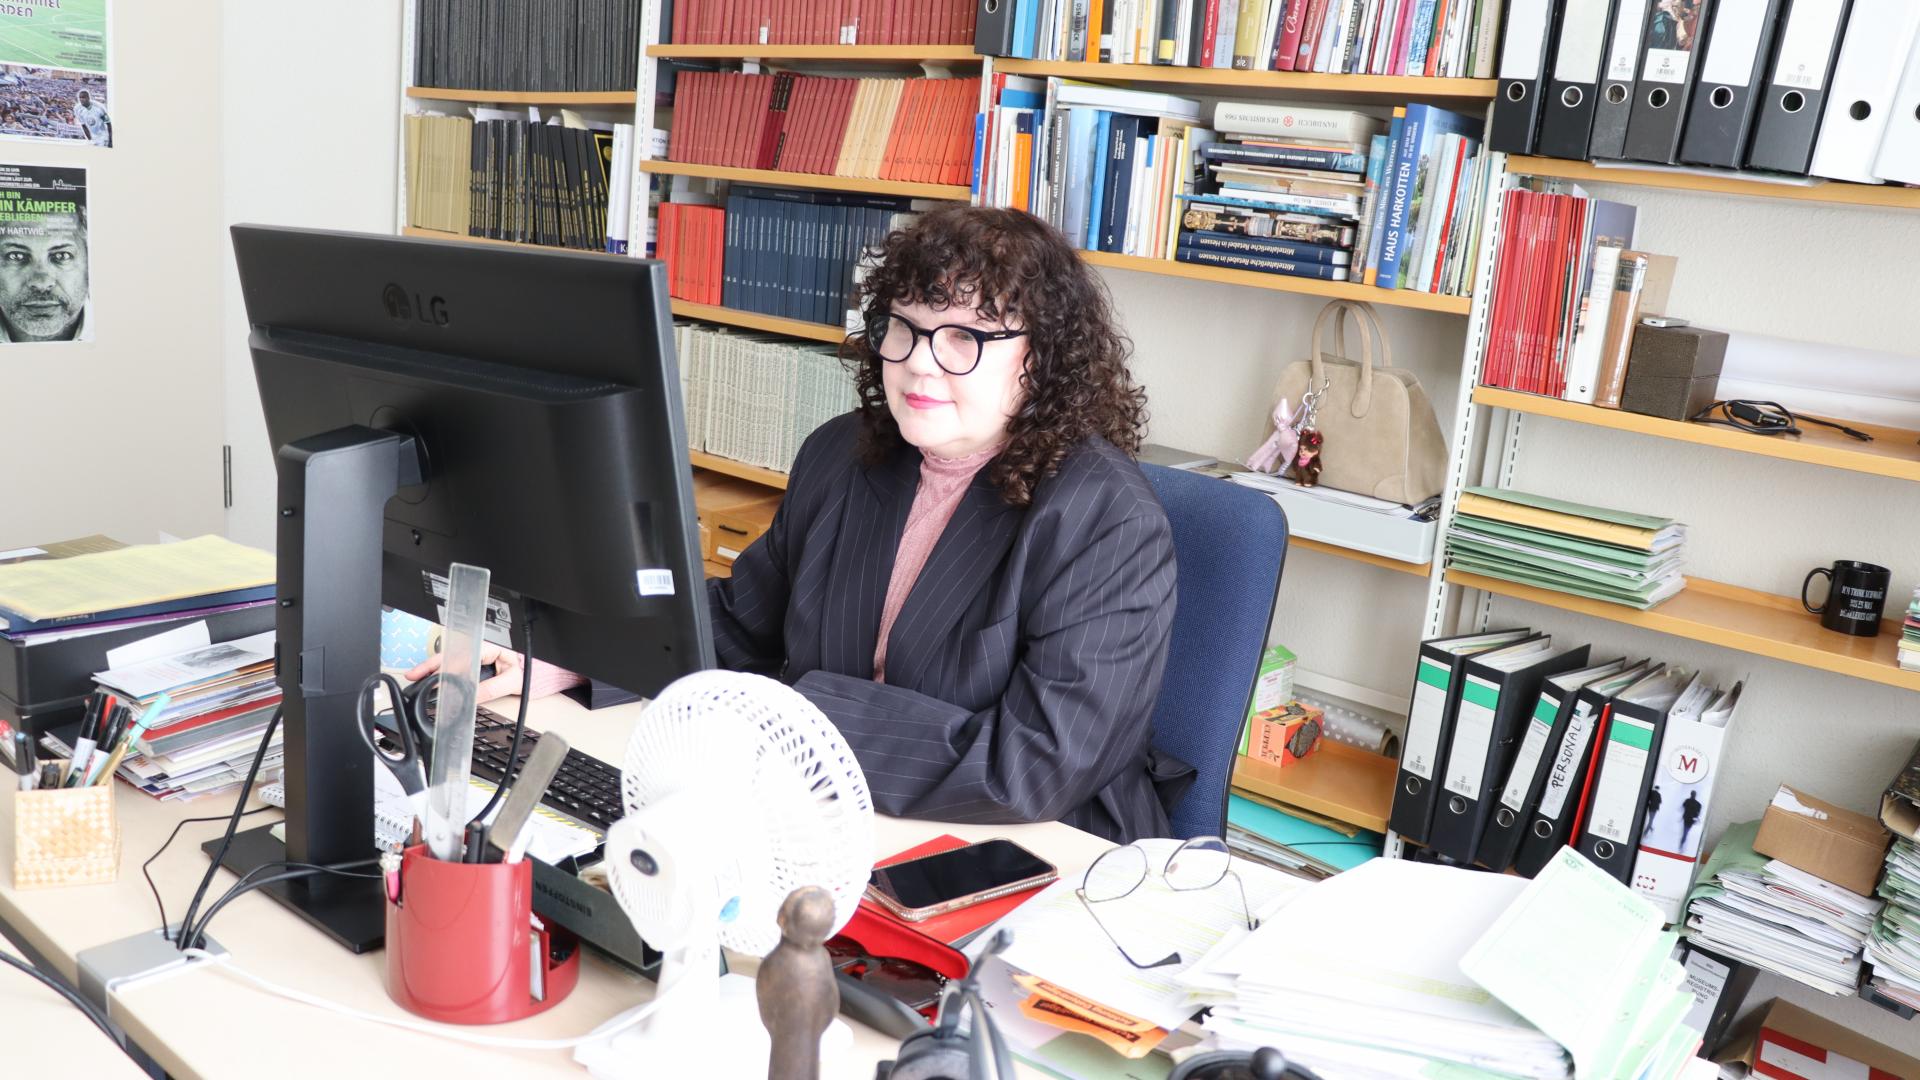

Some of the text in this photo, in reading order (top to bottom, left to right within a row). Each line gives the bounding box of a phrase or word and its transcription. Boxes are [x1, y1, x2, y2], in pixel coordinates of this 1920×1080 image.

[6, 191, 21, 199] BIN
[1390, 162, 1411, 228] HARKOTTEN
[16, 198, 77, 213] KÄMPFER
[7, 227, 45, 236] HARTWIG
[620, 243, 628, 252] K
[1200, 238, 1221, 247] Hessen
[1227, 240, 1250, 250] Retabel
[1250, 242, 1295, 255] Mittelalterliche
[1384, 231, 1399, 261] HAUS
[1198, 253, 1220, 262] Hessen
[1226, 255, 1249, 265] Retabel
[1249, 257, 1295, 271] Mittelalterliche
[414, 292, 449, 327] LG
[1551, 722, 1582, 789] PERSONAL
[1677, 754, 1698, 774] M
